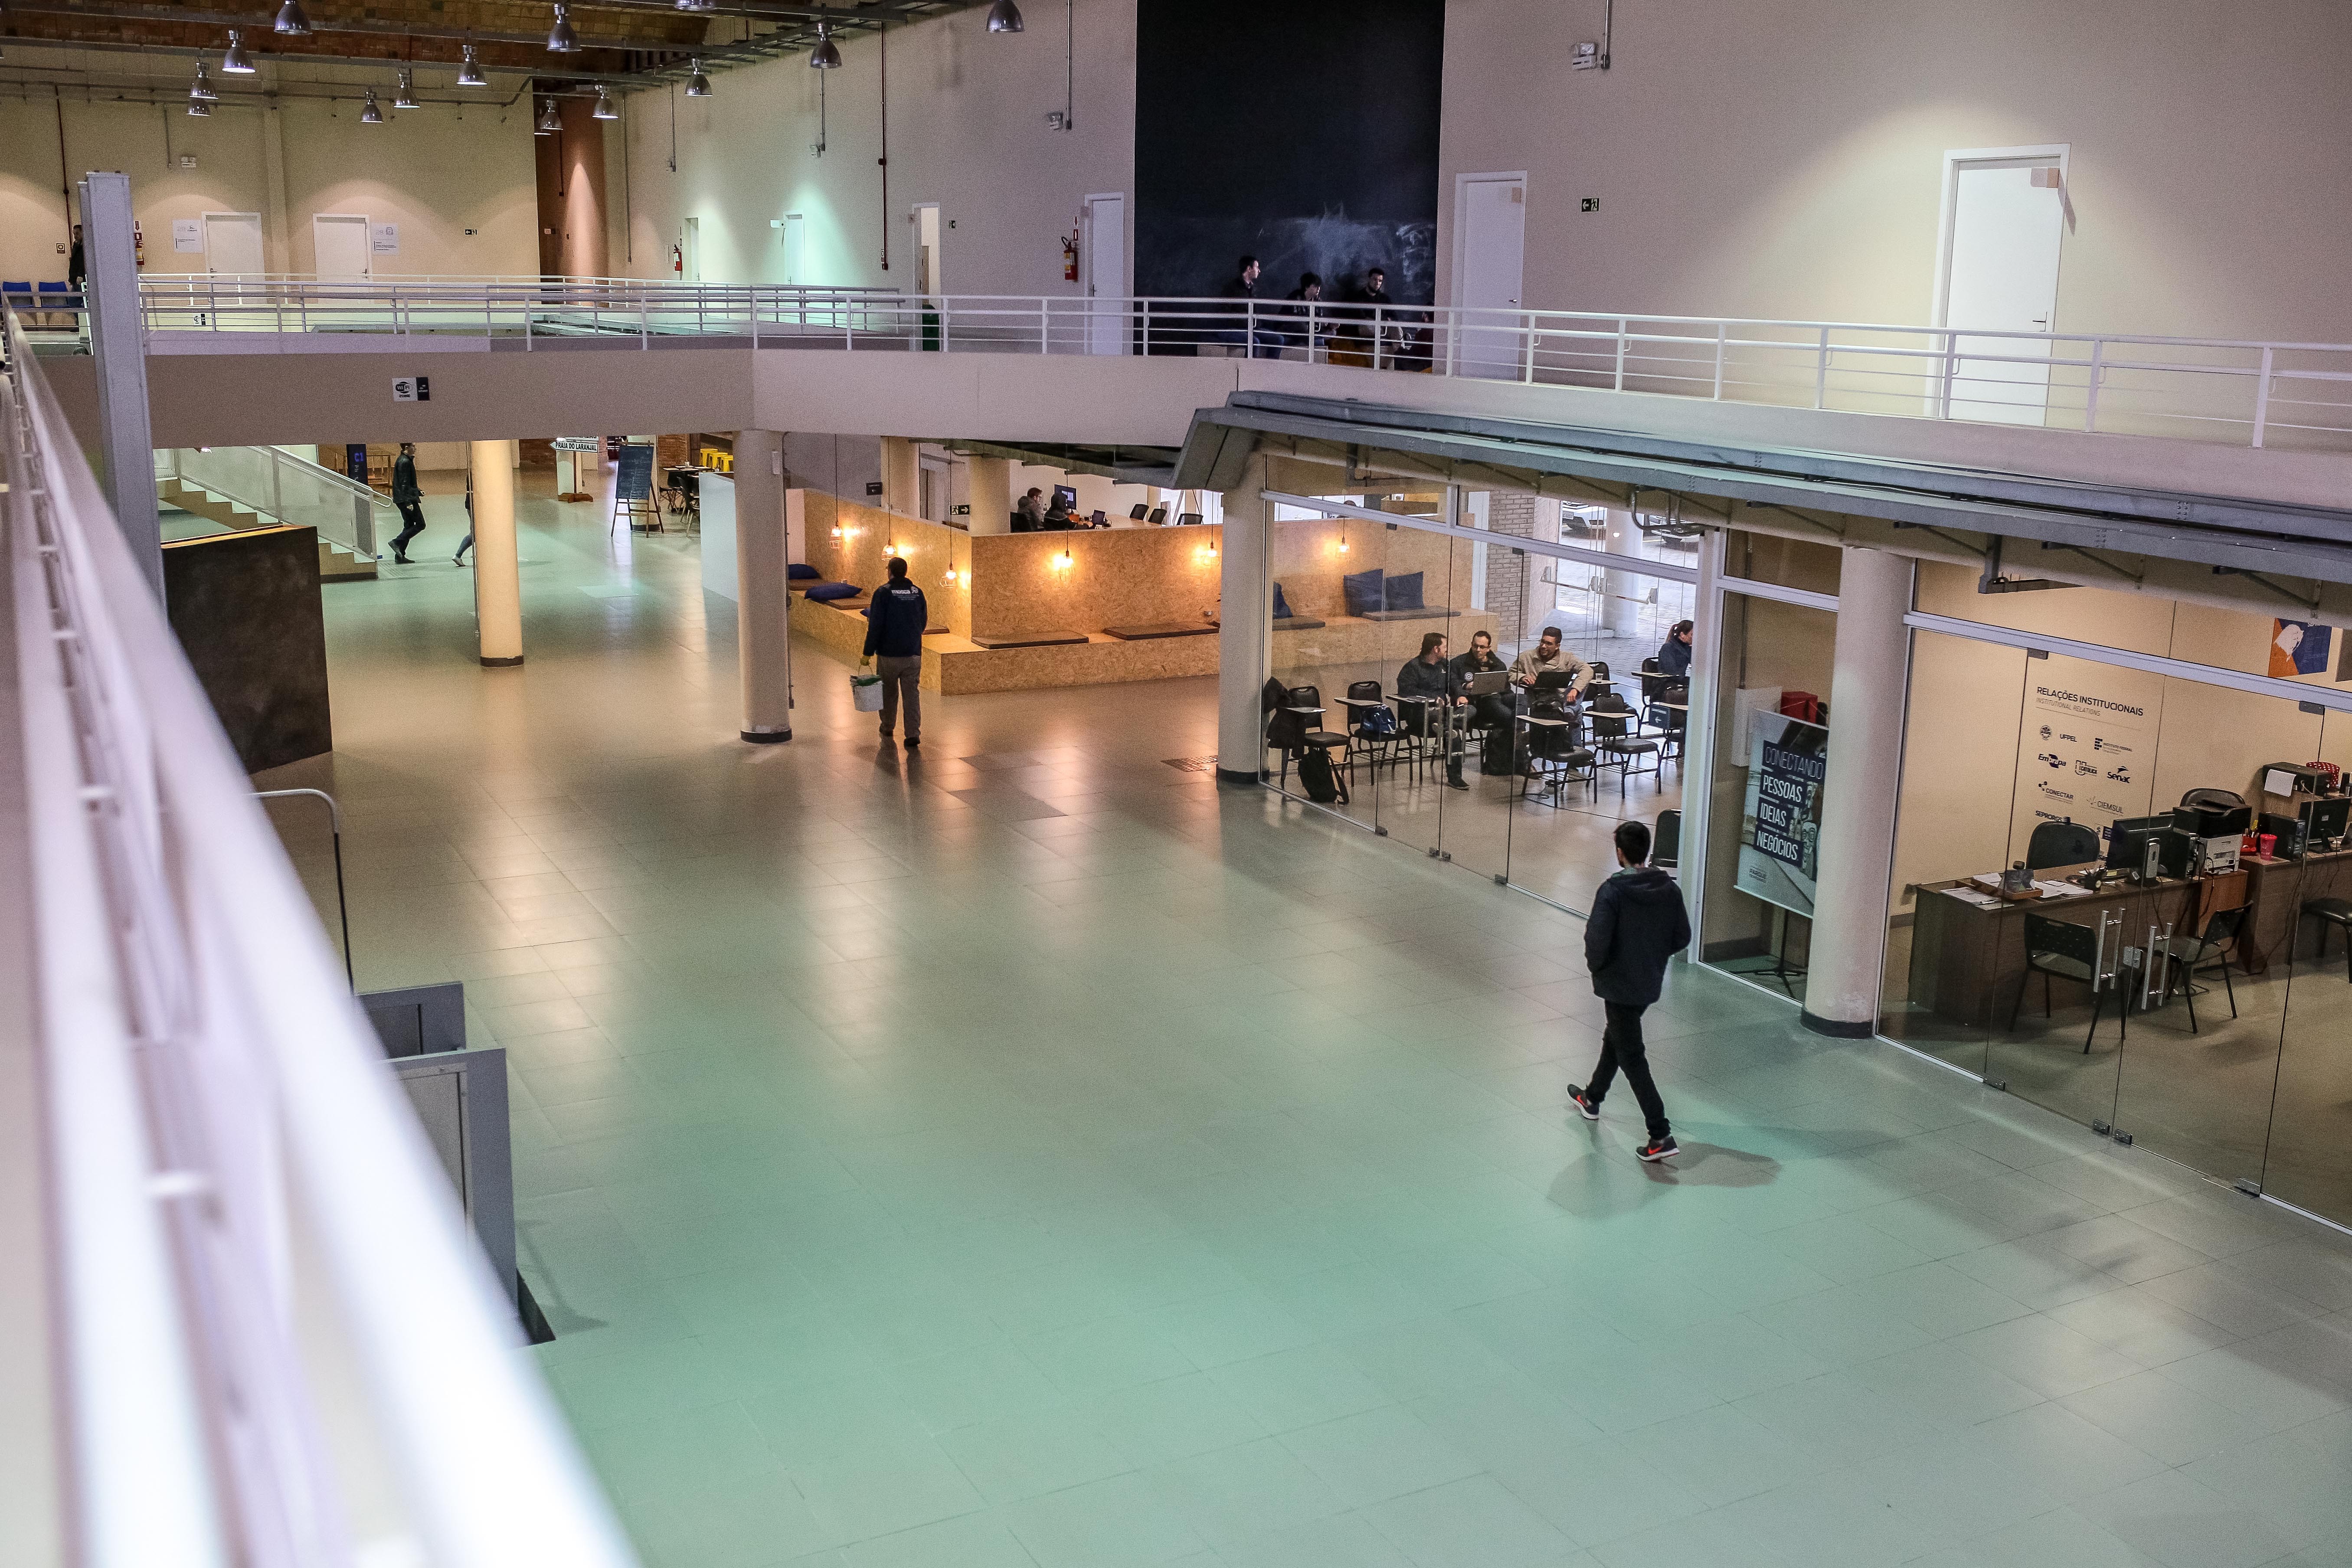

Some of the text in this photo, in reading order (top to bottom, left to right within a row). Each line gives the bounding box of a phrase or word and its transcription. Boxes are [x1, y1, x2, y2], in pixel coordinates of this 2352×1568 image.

[354, 452, 363, 462] C1
[2036, 697, 2101, 716] INSTITUTIONAL RELATIONS
[2037, 687, 2143, 716] RELAÇÕES INSTITUCIONAIS
[2060, 733, 2077, 742] UFPEL
[1765, 747, 1823, 779] CONECTANDO
[2038, 753, 2066, 766] Embrapa
[2107, 772, 2130, 783] Senac
[1763, 775, 1802, 803] PESSOAS
[2045, 788, 2074, 800] CONECTAR
[2097, 801, 2123, 814] CIEMSUL
[1760, 802, 1786, 827] IDEIAS
[2035, 810, 2062, 822] SEPRORGS
